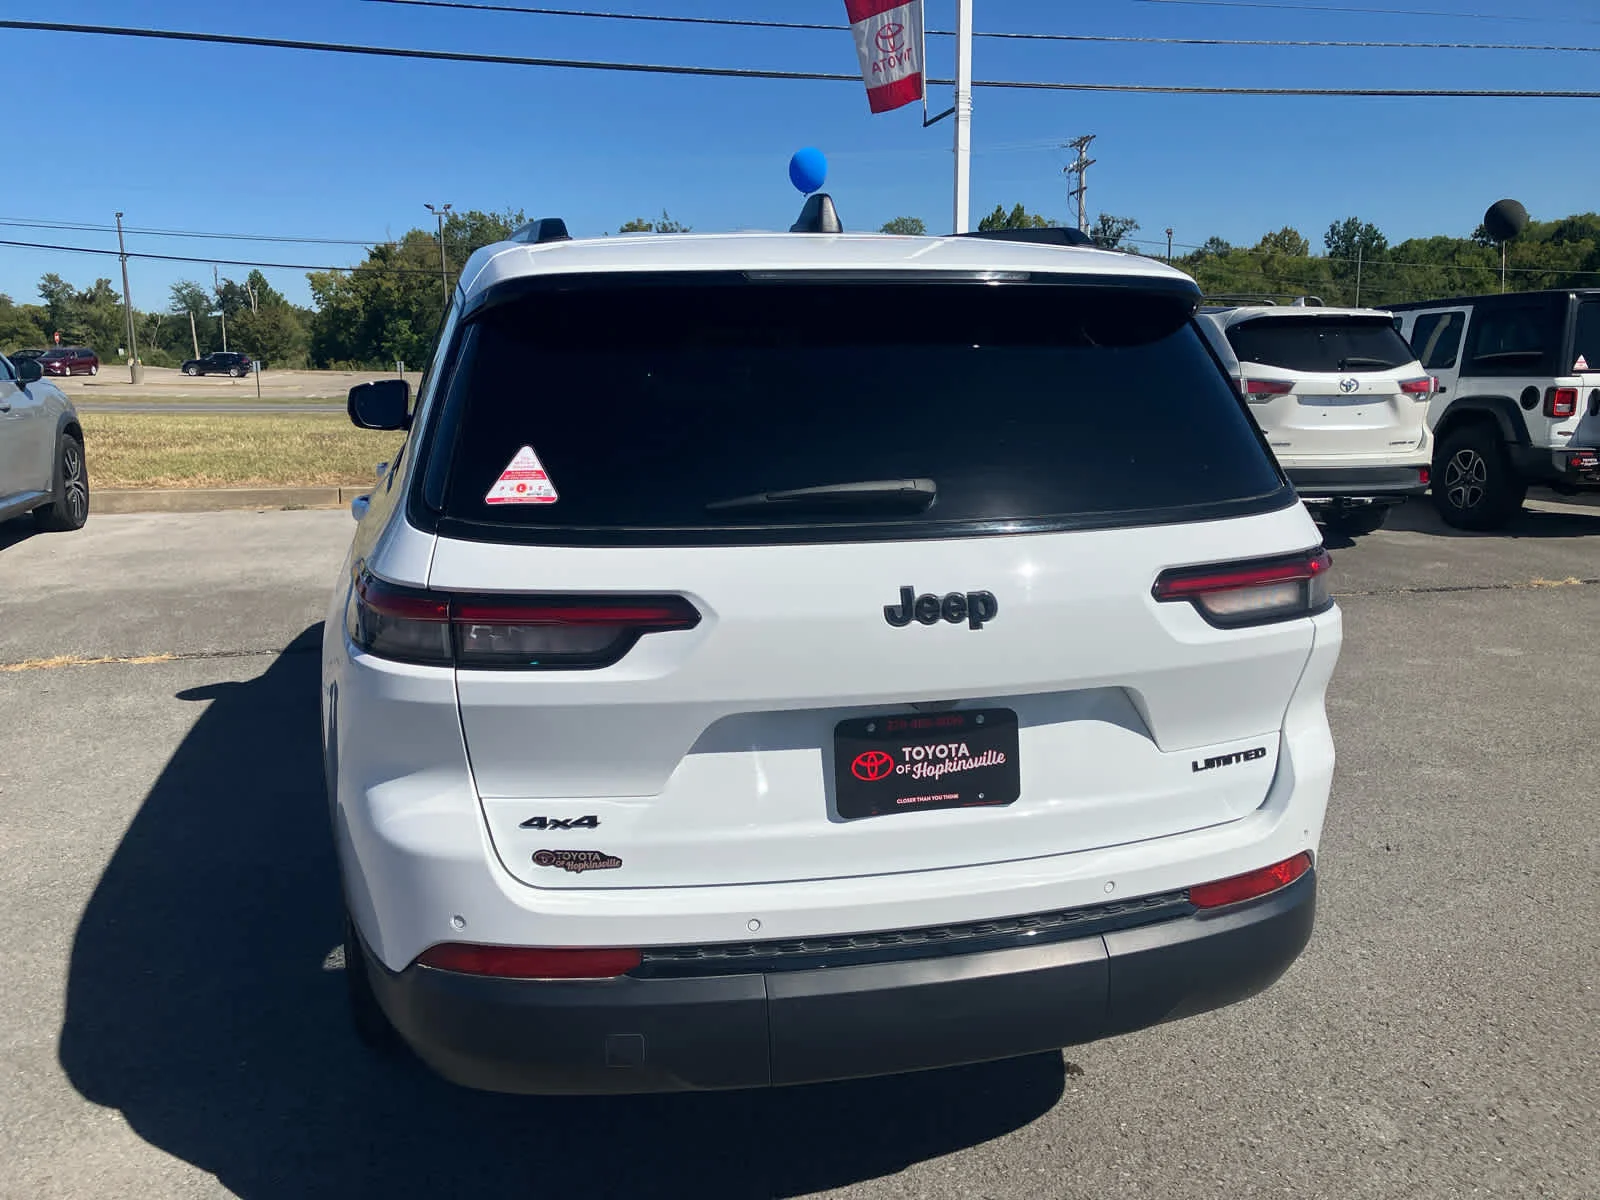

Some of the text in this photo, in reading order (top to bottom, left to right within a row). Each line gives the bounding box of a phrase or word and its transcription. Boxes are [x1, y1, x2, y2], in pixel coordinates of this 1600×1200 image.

[883, 585, 998, 630] Jeep
[902, 743, 970, 761] TOYOTA
[1191, 747, 1266, 772] LIMITED
[895, 749, 1006, 780] OF Hopkinsville
[896, 796, 916, 804] CLOSER
[555, 851, 600, 861] TOYOTA
[565, 858, 621, 872] Hopkinsville
